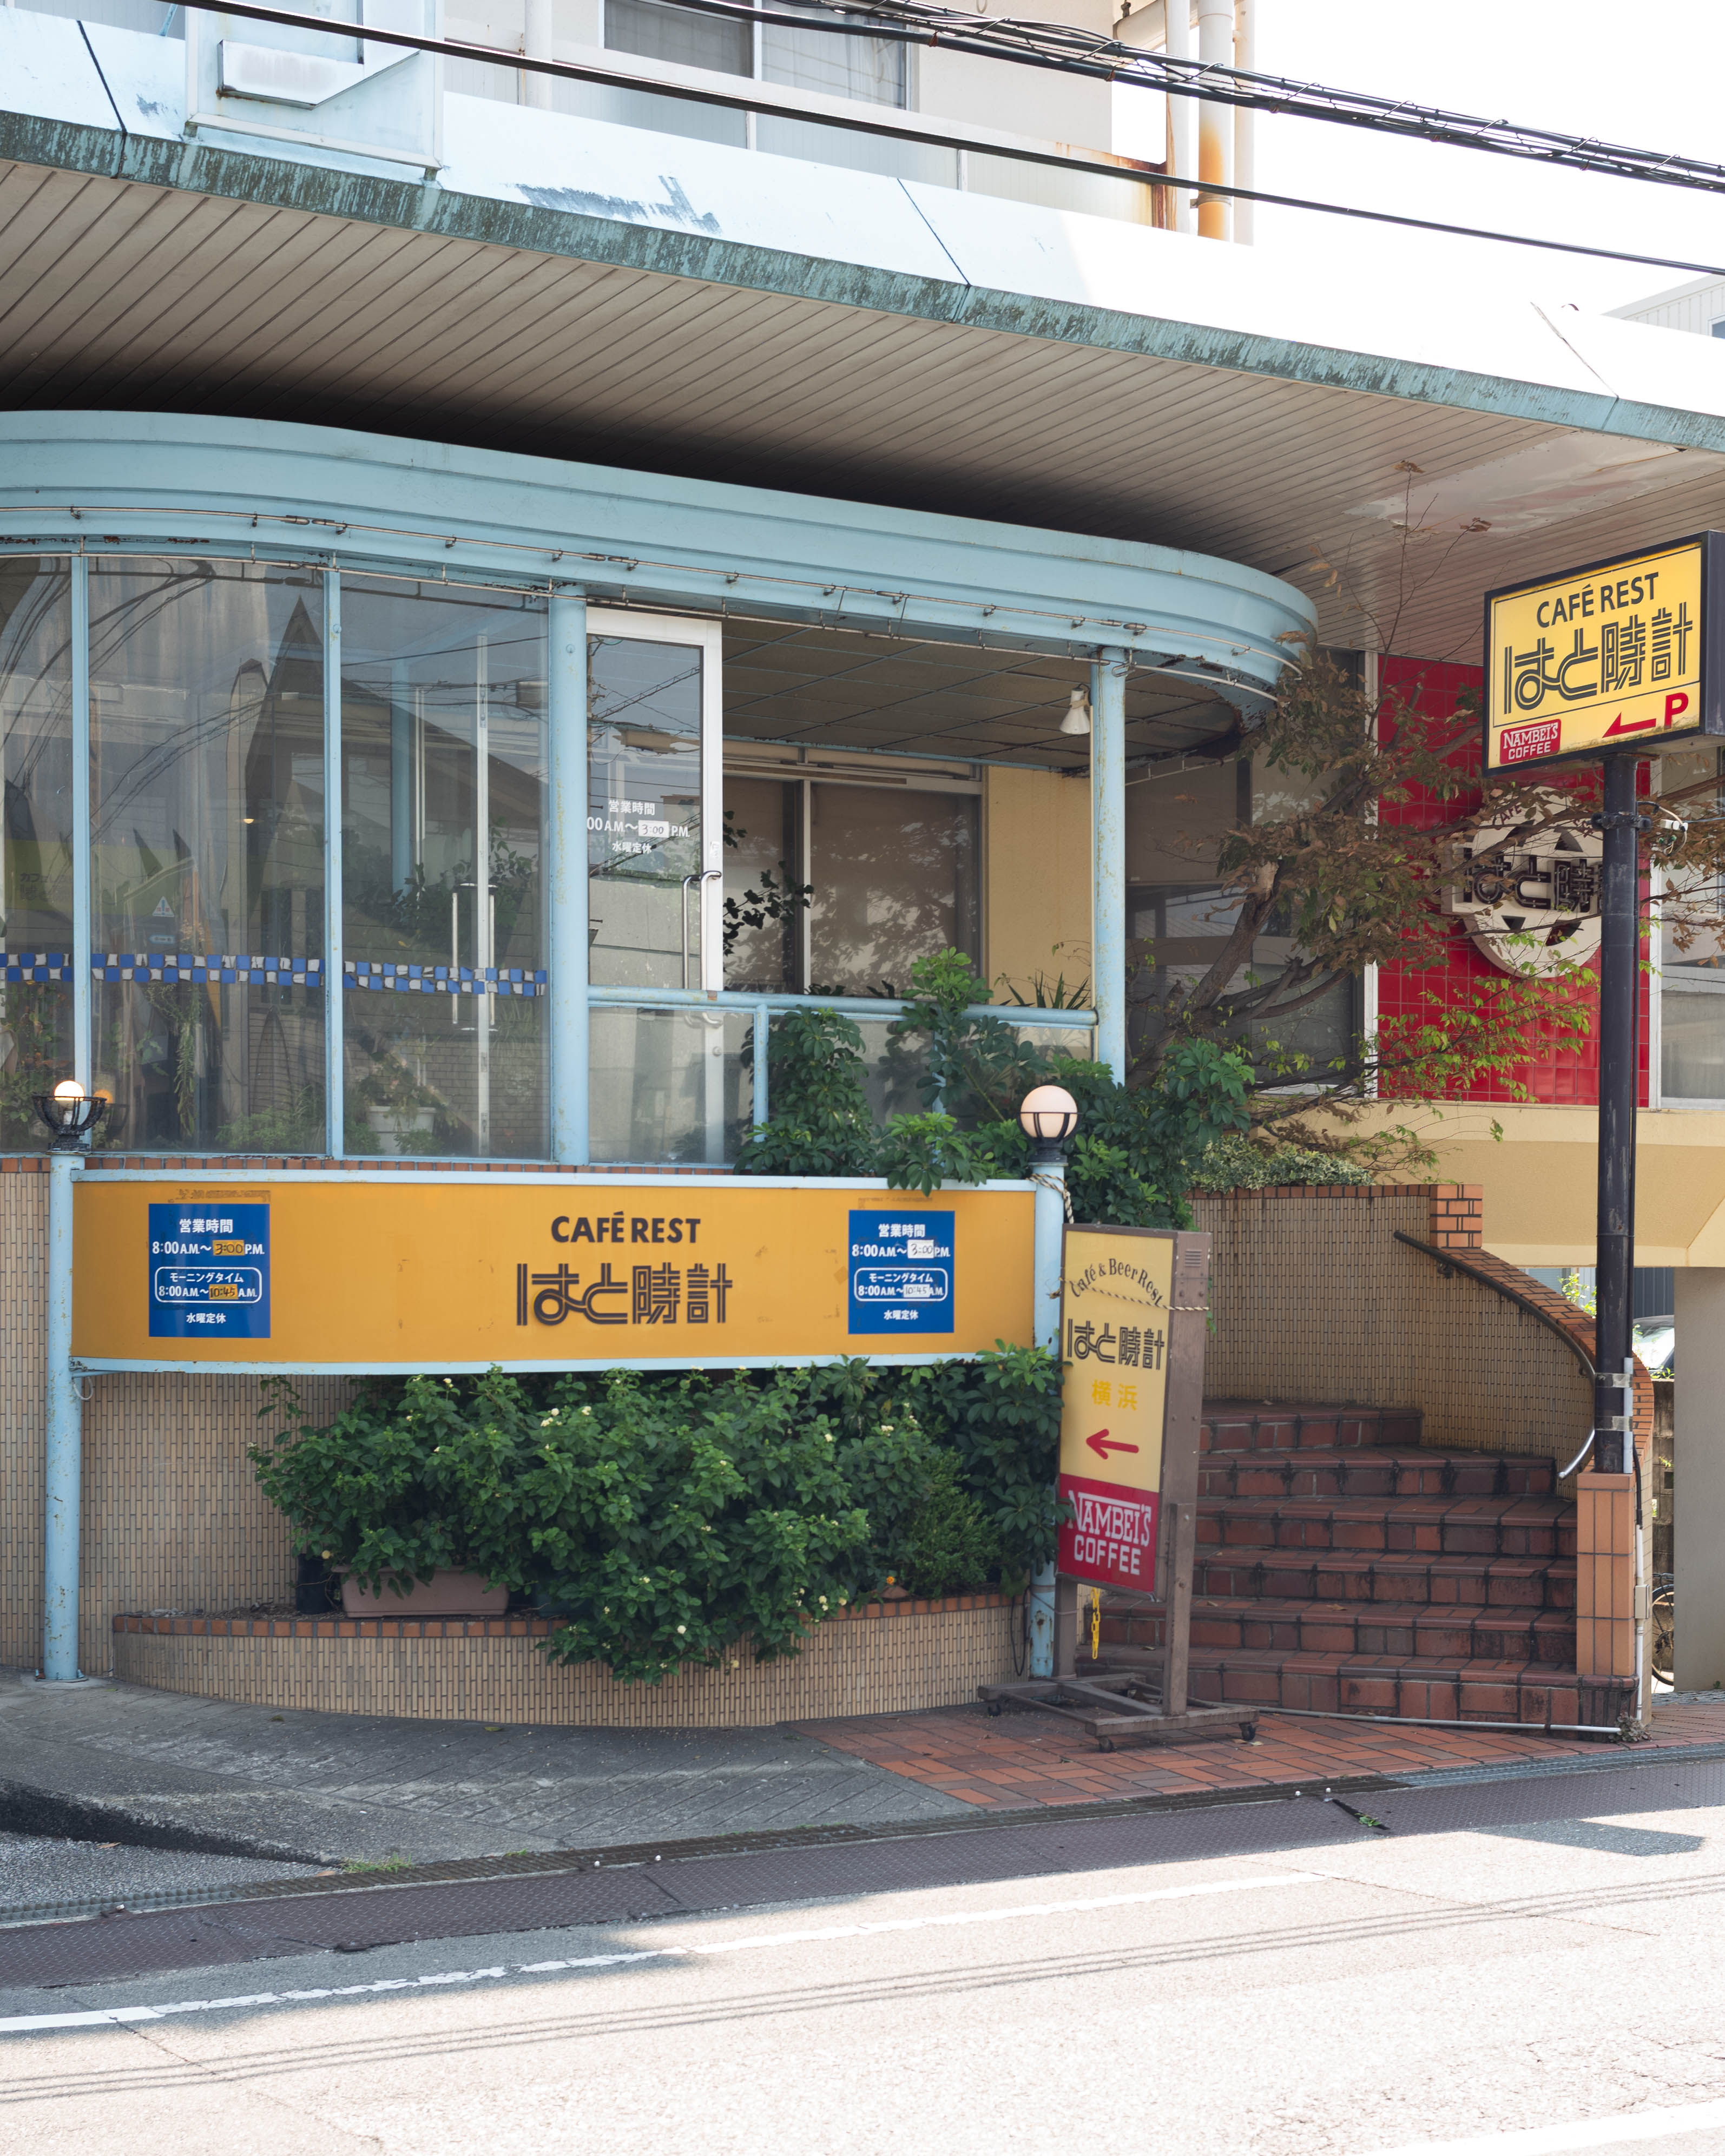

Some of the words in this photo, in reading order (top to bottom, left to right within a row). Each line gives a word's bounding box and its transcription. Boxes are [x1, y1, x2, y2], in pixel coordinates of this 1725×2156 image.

[1537, 584, 1595, 628] CAFÉ
[1601, 571, 1659, 613] REST
[1664, 692, 1689, 730] P
[1508, 742, 1551, 760] COFFEE
[608, 800, 655, 815] 営業時間
[612, 841, 652, 854] 水曜定休
[179, 1219, 233, 1234] 営業時間
[551, 1211, 625, 1243] CAFÉ
[631, 1217, 701, 1243] REST
[878, 1223, 925, 1237] 営業時間
[245, 1244, 265, 1255] P.M.
[170, 1272, 244, 1283] モーニングタイム
[868, 1273, 933, 1282] モーニングタイム
[1070, 1263, 1096, 1297] Café
[1098, 1263, 1107, 1277] &
[1109, 1258, 1138, 1281] Beer
[1138, 1268, 1165, 1307] Rest
[186, 1313, 226, 1323] 水曜定休
[884, 1310, 918, 1320] 水曜定休
[1091, 1379, 1137, 1410] 横浜
[1074, 1535, 1141, 1575] COFFEE
